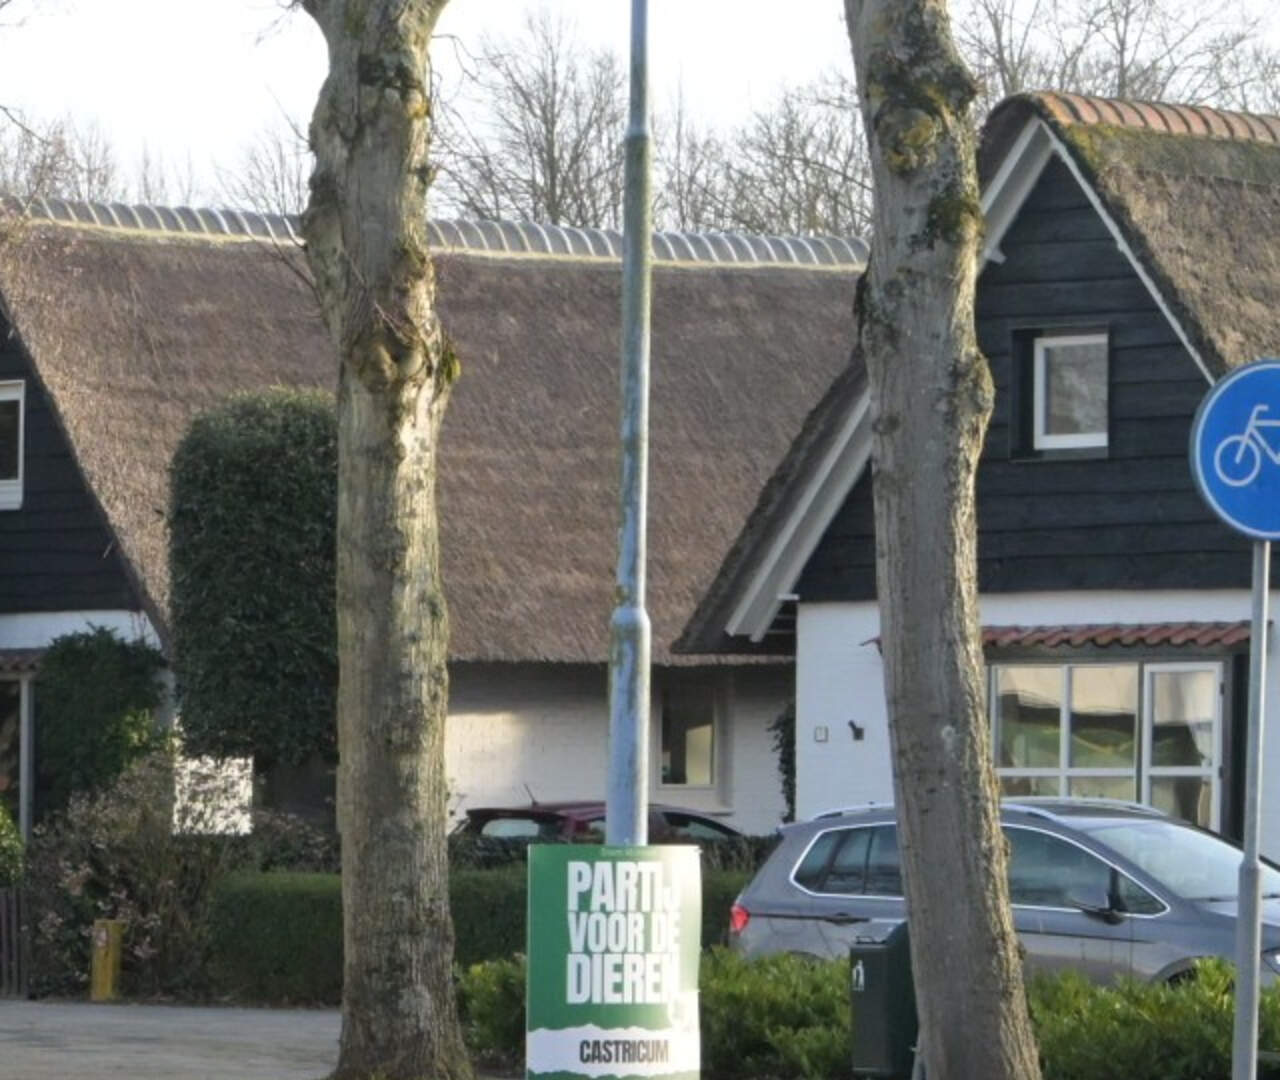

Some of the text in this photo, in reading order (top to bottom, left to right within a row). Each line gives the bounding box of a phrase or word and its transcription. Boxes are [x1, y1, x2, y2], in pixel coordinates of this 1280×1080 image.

[567, 861, 682, 912] PARTIJ
[567, 911, 682, 953] VOOR DE
[566, 953, 682, 1005] DIEREN
[579, 1039, 670, 1064] CASTRICUM
